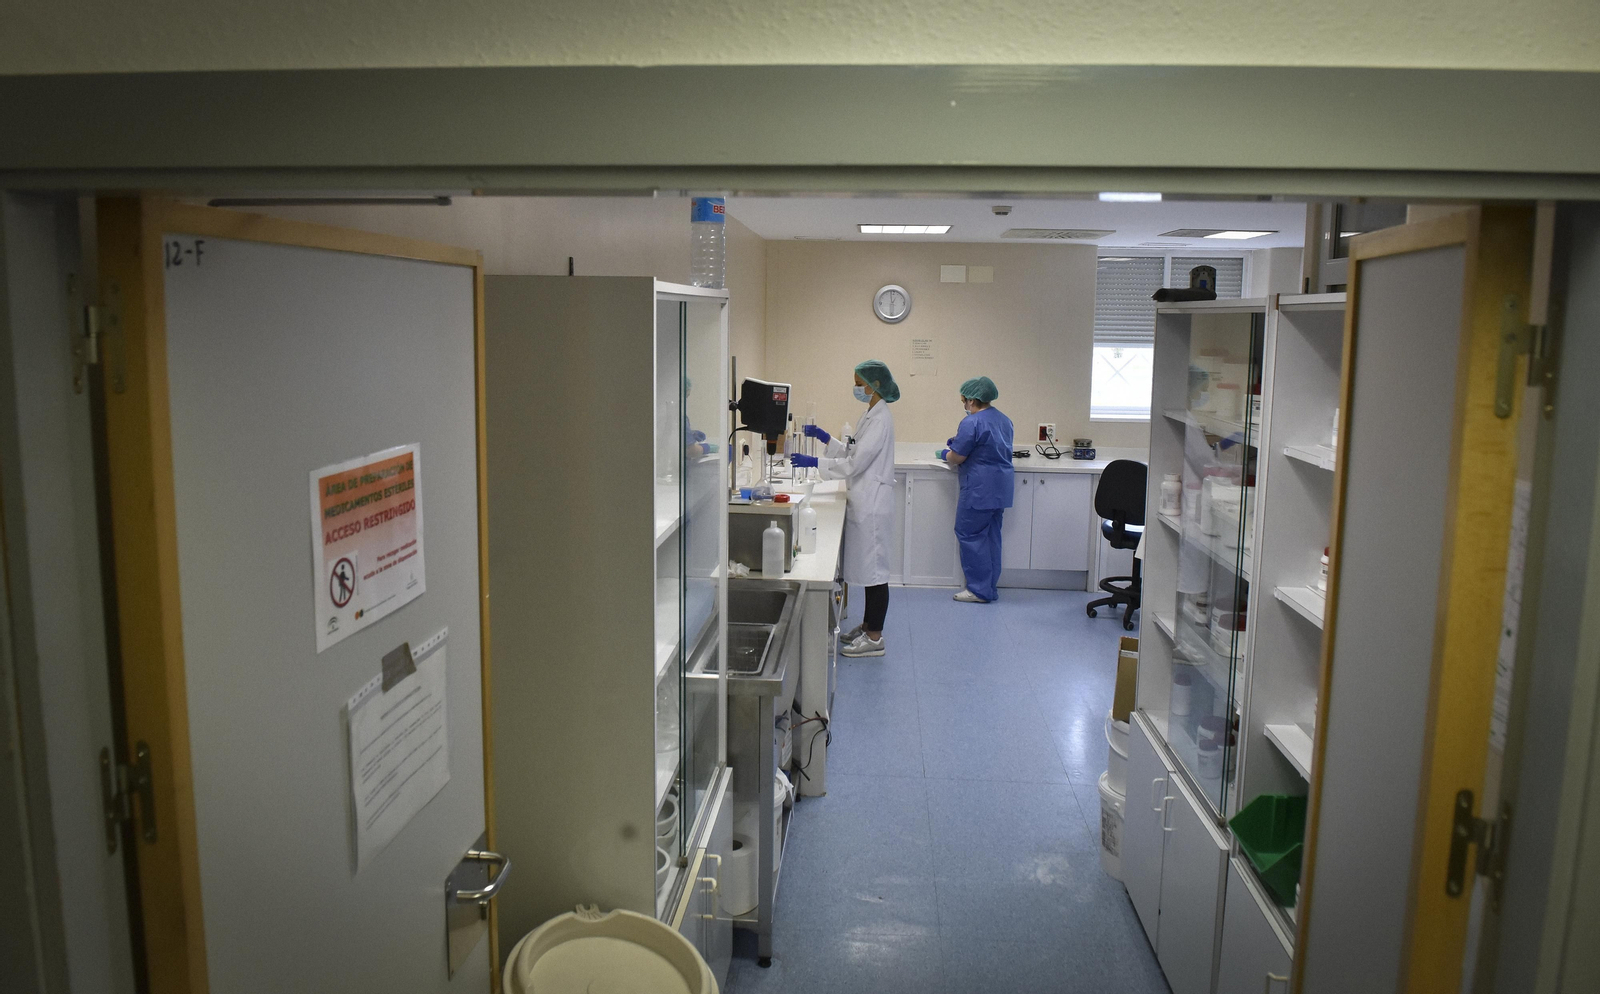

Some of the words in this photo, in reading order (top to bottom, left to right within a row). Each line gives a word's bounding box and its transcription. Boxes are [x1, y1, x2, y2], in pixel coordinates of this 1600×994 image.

[165, 240, 205, 269] 12-F
[348, 477, 358, 490] DE
[405, 460, 413, 471] DE
[324, 490, 383, 519] MEDICAMENTOS
[325, 520, 362, 546] ACCESO
[363, 498, 416, 530] RESTRINGIDO
